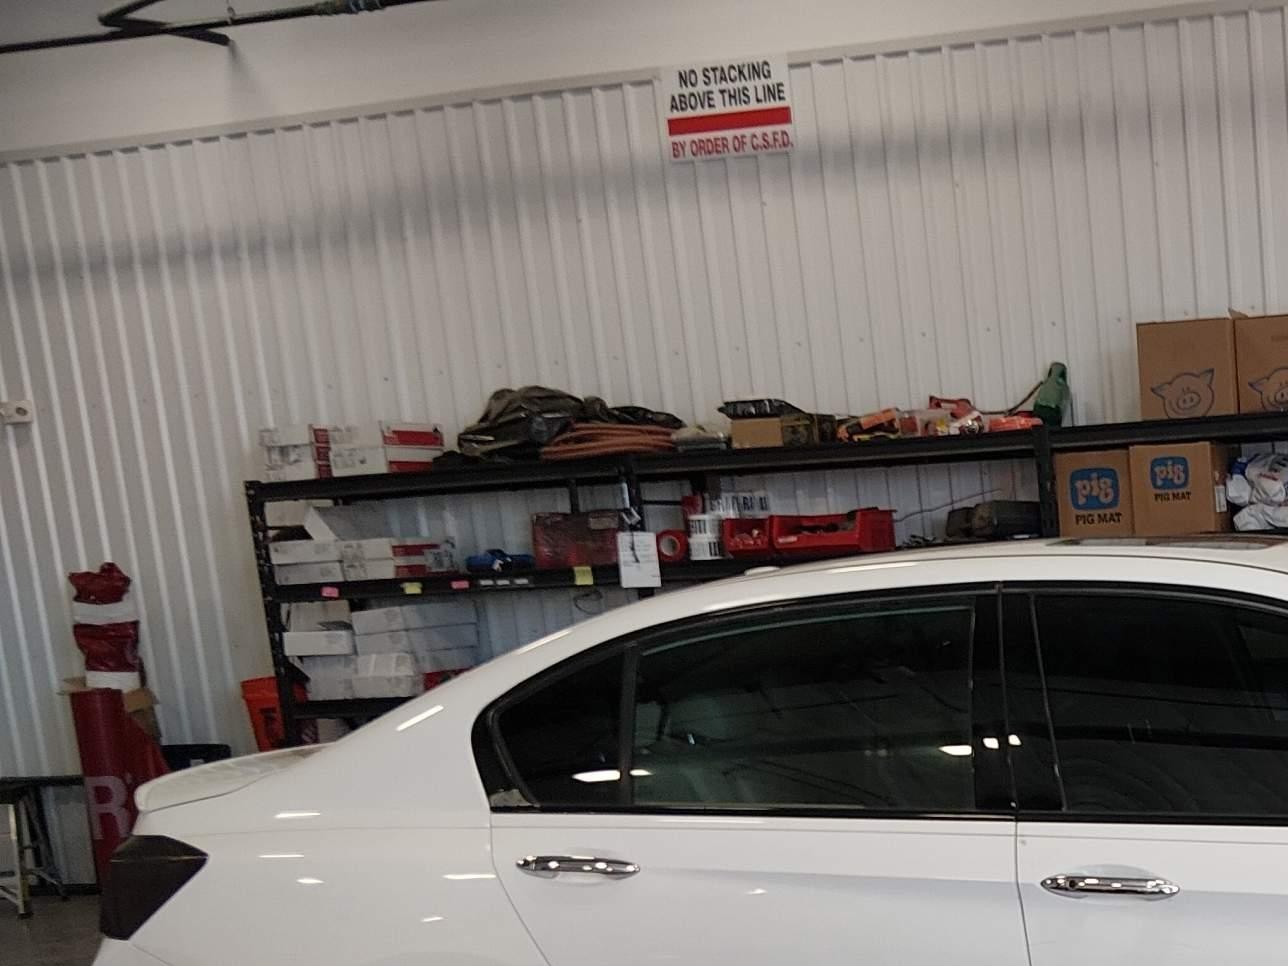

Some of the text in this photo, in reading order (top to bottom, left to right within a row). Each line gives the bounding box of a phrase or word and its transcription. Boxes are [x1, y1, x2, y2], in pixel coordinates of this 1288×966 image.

[679, 60, 772, 88] NO STACKING
[670, 82, 786, 112] ABOVE THIS LINE
[671, 130, 794, 158] BY ORDER OF C.S.F.D.
[1153, 460, 1185, 486] pig
[1074, 472, 1115, 506] pig
[1154, 491, 1192, 502] PIG MAT
[1075, 512, 1122, 525] PIG MAT
